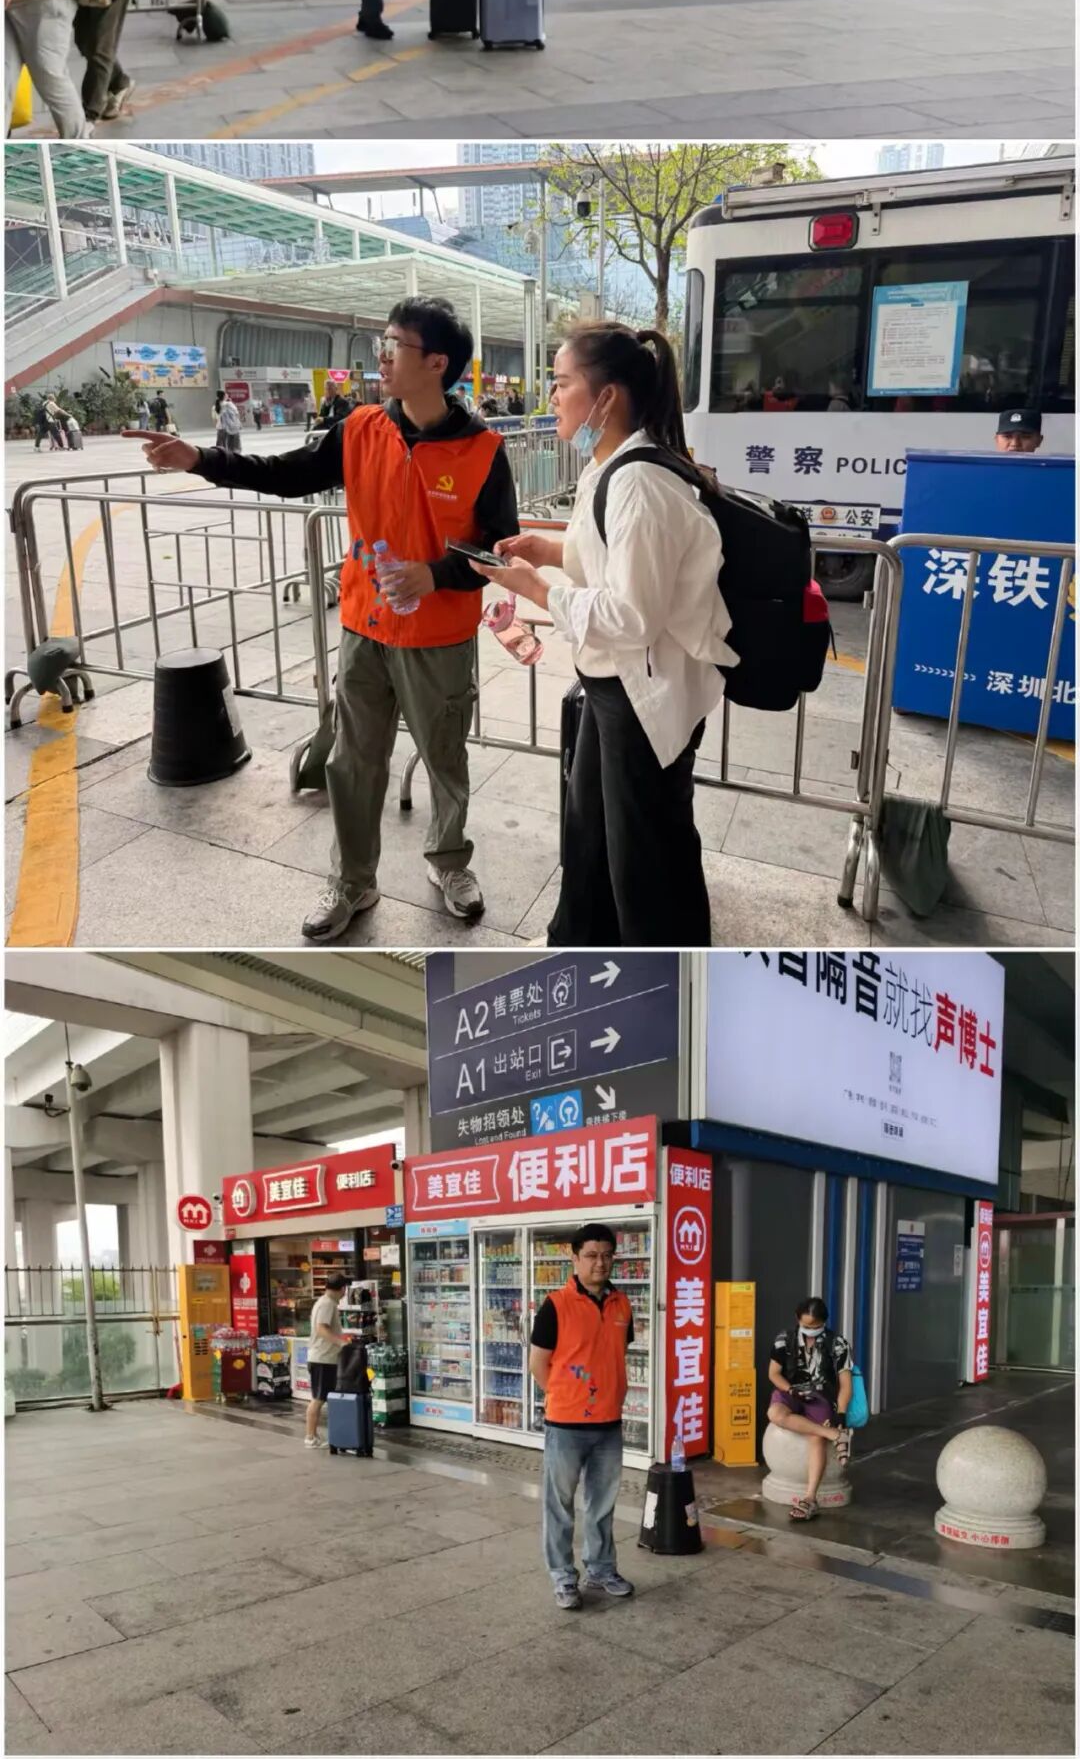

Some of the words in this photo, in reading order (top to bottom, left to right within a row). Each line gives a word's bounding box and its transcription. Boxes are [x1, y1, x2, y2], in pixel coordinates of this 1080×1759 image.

[746, 445, 824, 475] 警察
[845, 509, 874, 527] 公安
[922, 547, 1050, 610] 深铁
[986, 670, 1075, 705] 深圳北
[493, 982, 543, 1019] 售票处
[454, 1001, 490, 1045] A2
[513, 1009, 541, 1026] Tickets
[494, 1044, 542, 1076] 出站口
[525, 1069, 542, 1082] Exit
[456, 1058, 486, 1099] A1
[458, 1105, 525, 1137] 失物招领处
[504, 1128, 527, 1140] Found
[336, 1169, 373, 1191] 便利店
[507, 1131, 650, 1203] 便利店
[670, 1162, 711, 1192] 便利店
[269, 1176, 306, 1202] 美宜佳
[427, 1169, 482, 1200] 美宜佳
[976, 1270, 990, 1376] 美宜佳
[673, 1276, 706, 1444] 美宜佳
